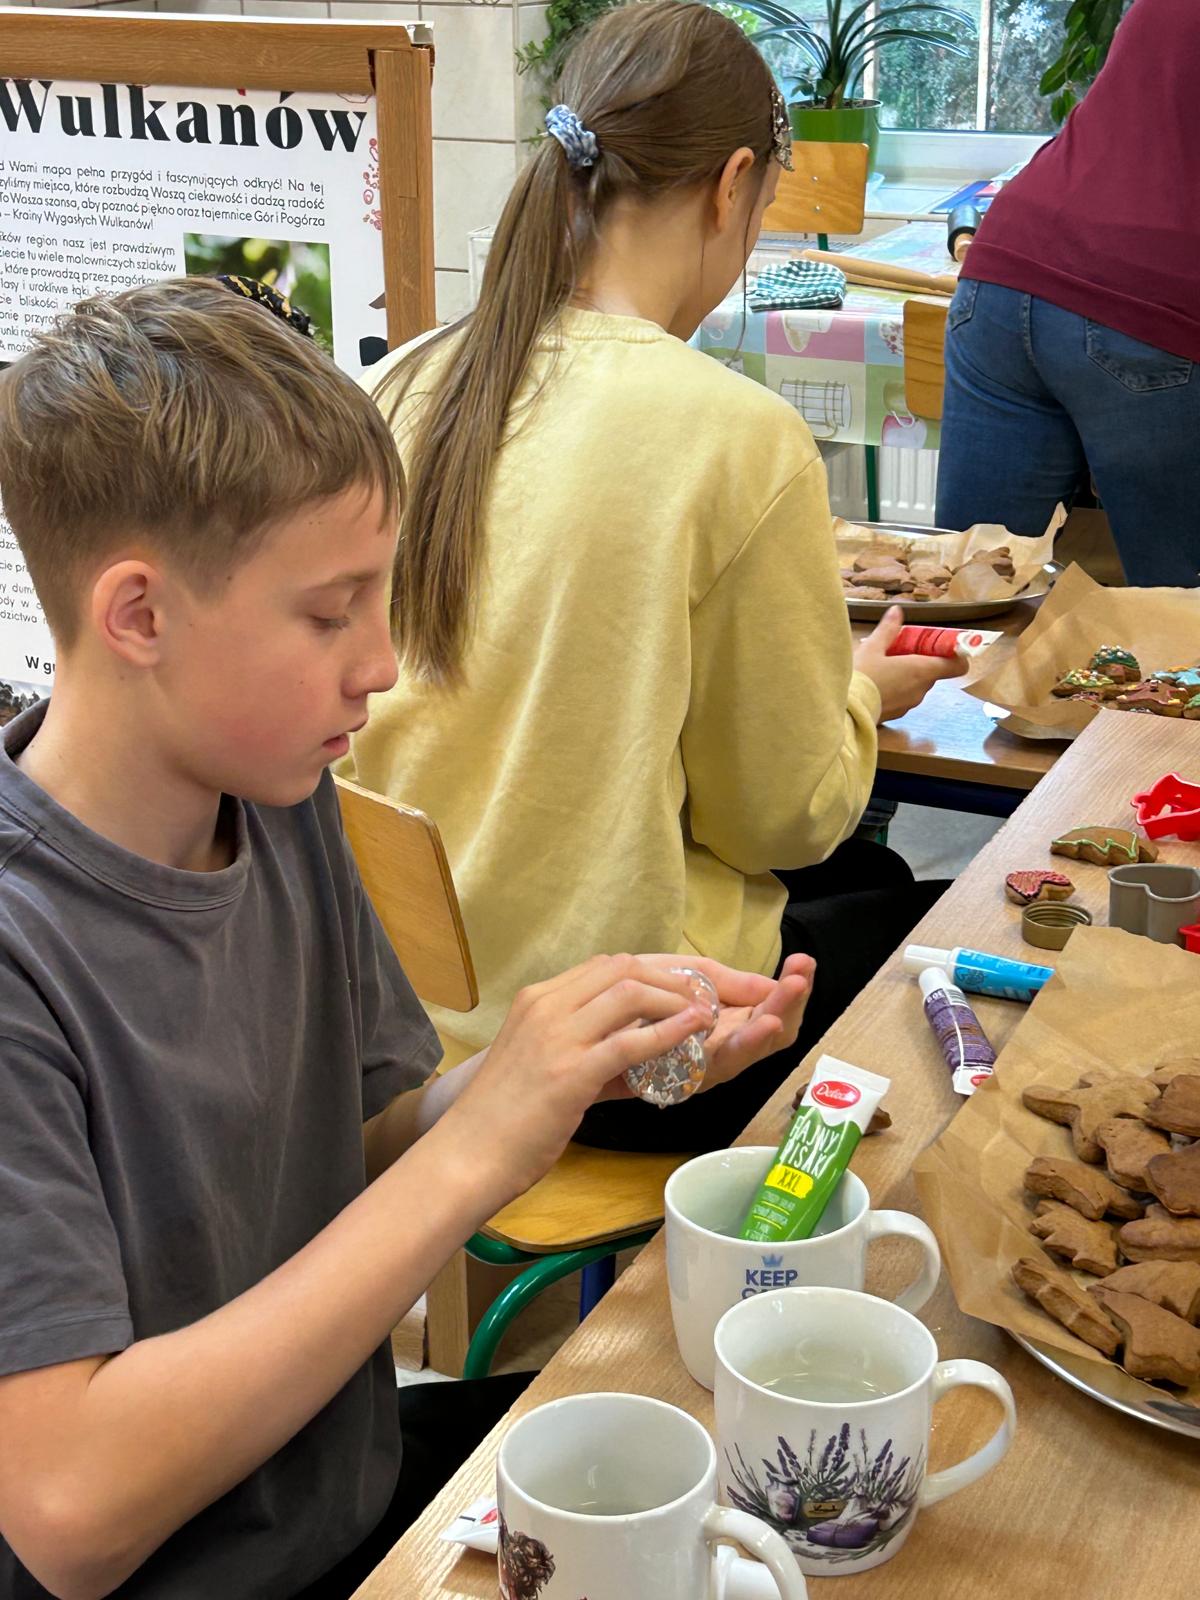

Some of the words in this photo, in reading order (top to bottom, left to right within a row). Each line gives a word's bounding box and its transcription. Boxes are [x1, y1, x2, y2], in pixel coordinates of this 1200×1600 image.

[0, 79, 368, 153] Wulkanów
[9, 160, 38, 173] Wami
[42, 165, 72, 178] mapa
[77, 166, 106, 179] pełna
[111, 169, 153, 183] przygód
[166, 171, 239, 190] fascynujących
[243, 177, 283, 193] odkryć!
[288, 179, 305, 192] Na
[310, 181, 324, 196] tej
[33, 179, 73, 195] miejsca,
[75, 181, 100, 194] które
[102, 184, 150, 201] rozbudzą
[150, 186, 187, 204] Waszą
[188, 189, 243, 204] ciekawość
[250, 194, 286, 210] dadzą
[288, 197, 325, 210] radość
[10, 192, 43, 206] Wasza
[44, 197, 80, 211] szansa,
[81, 197, 100, 213] aby
[101, 201, 140, 213] poznać
[141, 203, 175, 217] piękno
[176, 207, 200, 218] oraz
[201, 207, 253, 222] tajemnice
[254, 210, 274, 223] Gór
[280, 212, 325, 228] Pogórza
[12, 208, 43, 224] Krainy
[43, 210, 98, 227] Wygasłych
[98, 214, 154, 231] Wulkanów!
[26, 234, 58, 248] region
[62, 238, 86, 250] nasz
[90, 238, 107, 252] jest
[112, 242, 176, 258] prawdziwym
[27, 249, 37, 261] tu
[37, 250, 65, 263] wiele
[66, 253, 135, 271] malowniczych
[136, 258, 177, 273] szlaków
[30, 267, 81, 284] prowadzą
[82, 272, 109, 284] przez
[29, 281, 69, 295] urokliwe
[19, 294, 59, 309] bliskości
[25, 655, 40, 670] W
[777, 1168, 802, 1193] XXL
[745, 1268, 798, 1287] KEEP
